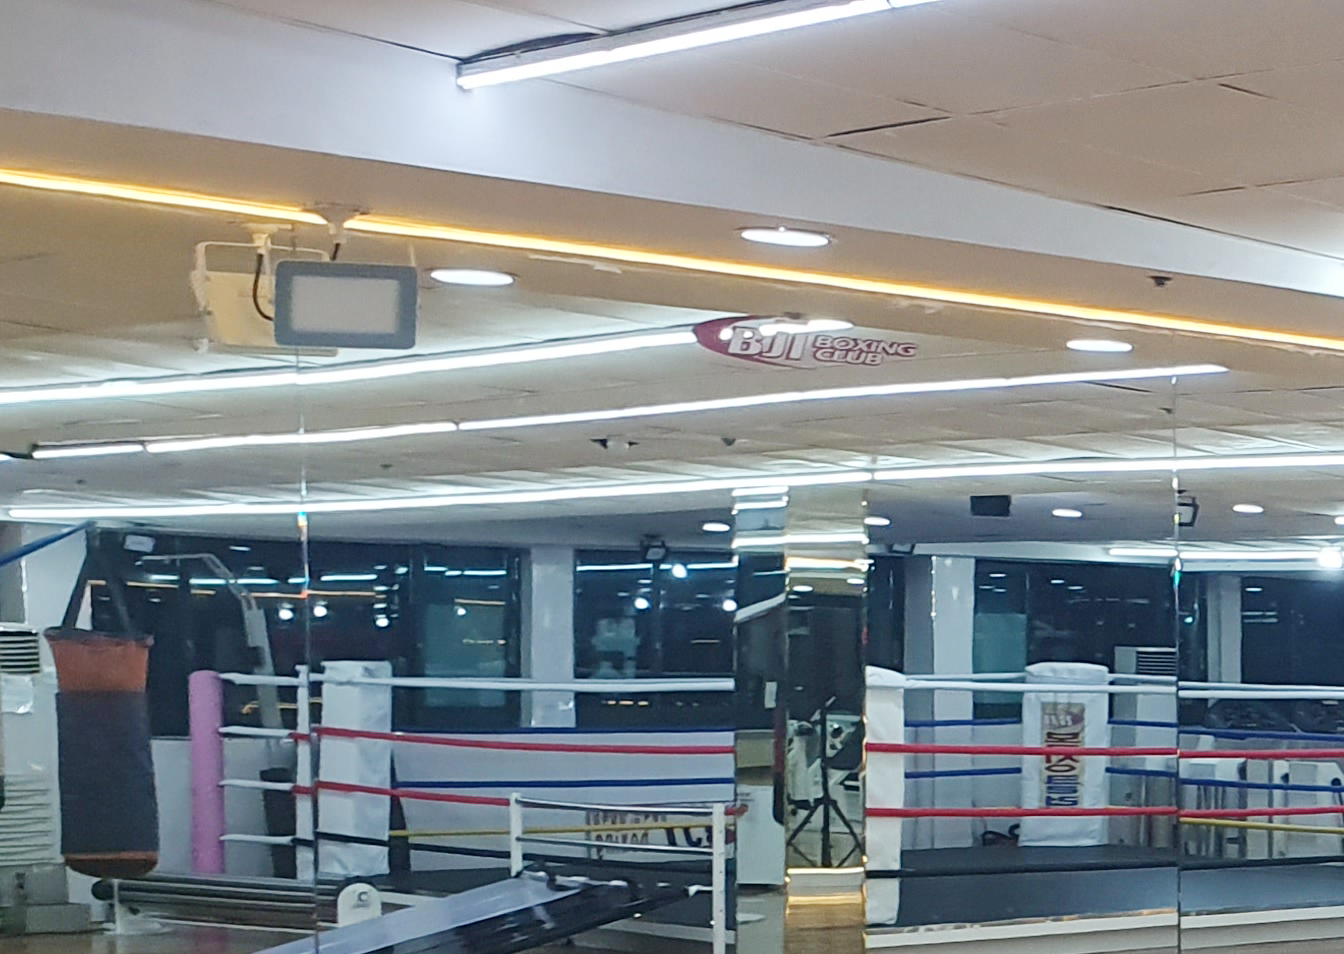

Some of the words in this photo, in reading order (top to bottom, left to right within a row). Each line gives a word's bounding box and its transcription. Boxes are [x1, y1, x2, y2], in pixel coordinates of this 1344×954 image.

[727, 325, 808, 361] BJI
[813, 334, 918, 357] BOXING
[812, 347, 884, 366] CLUB
